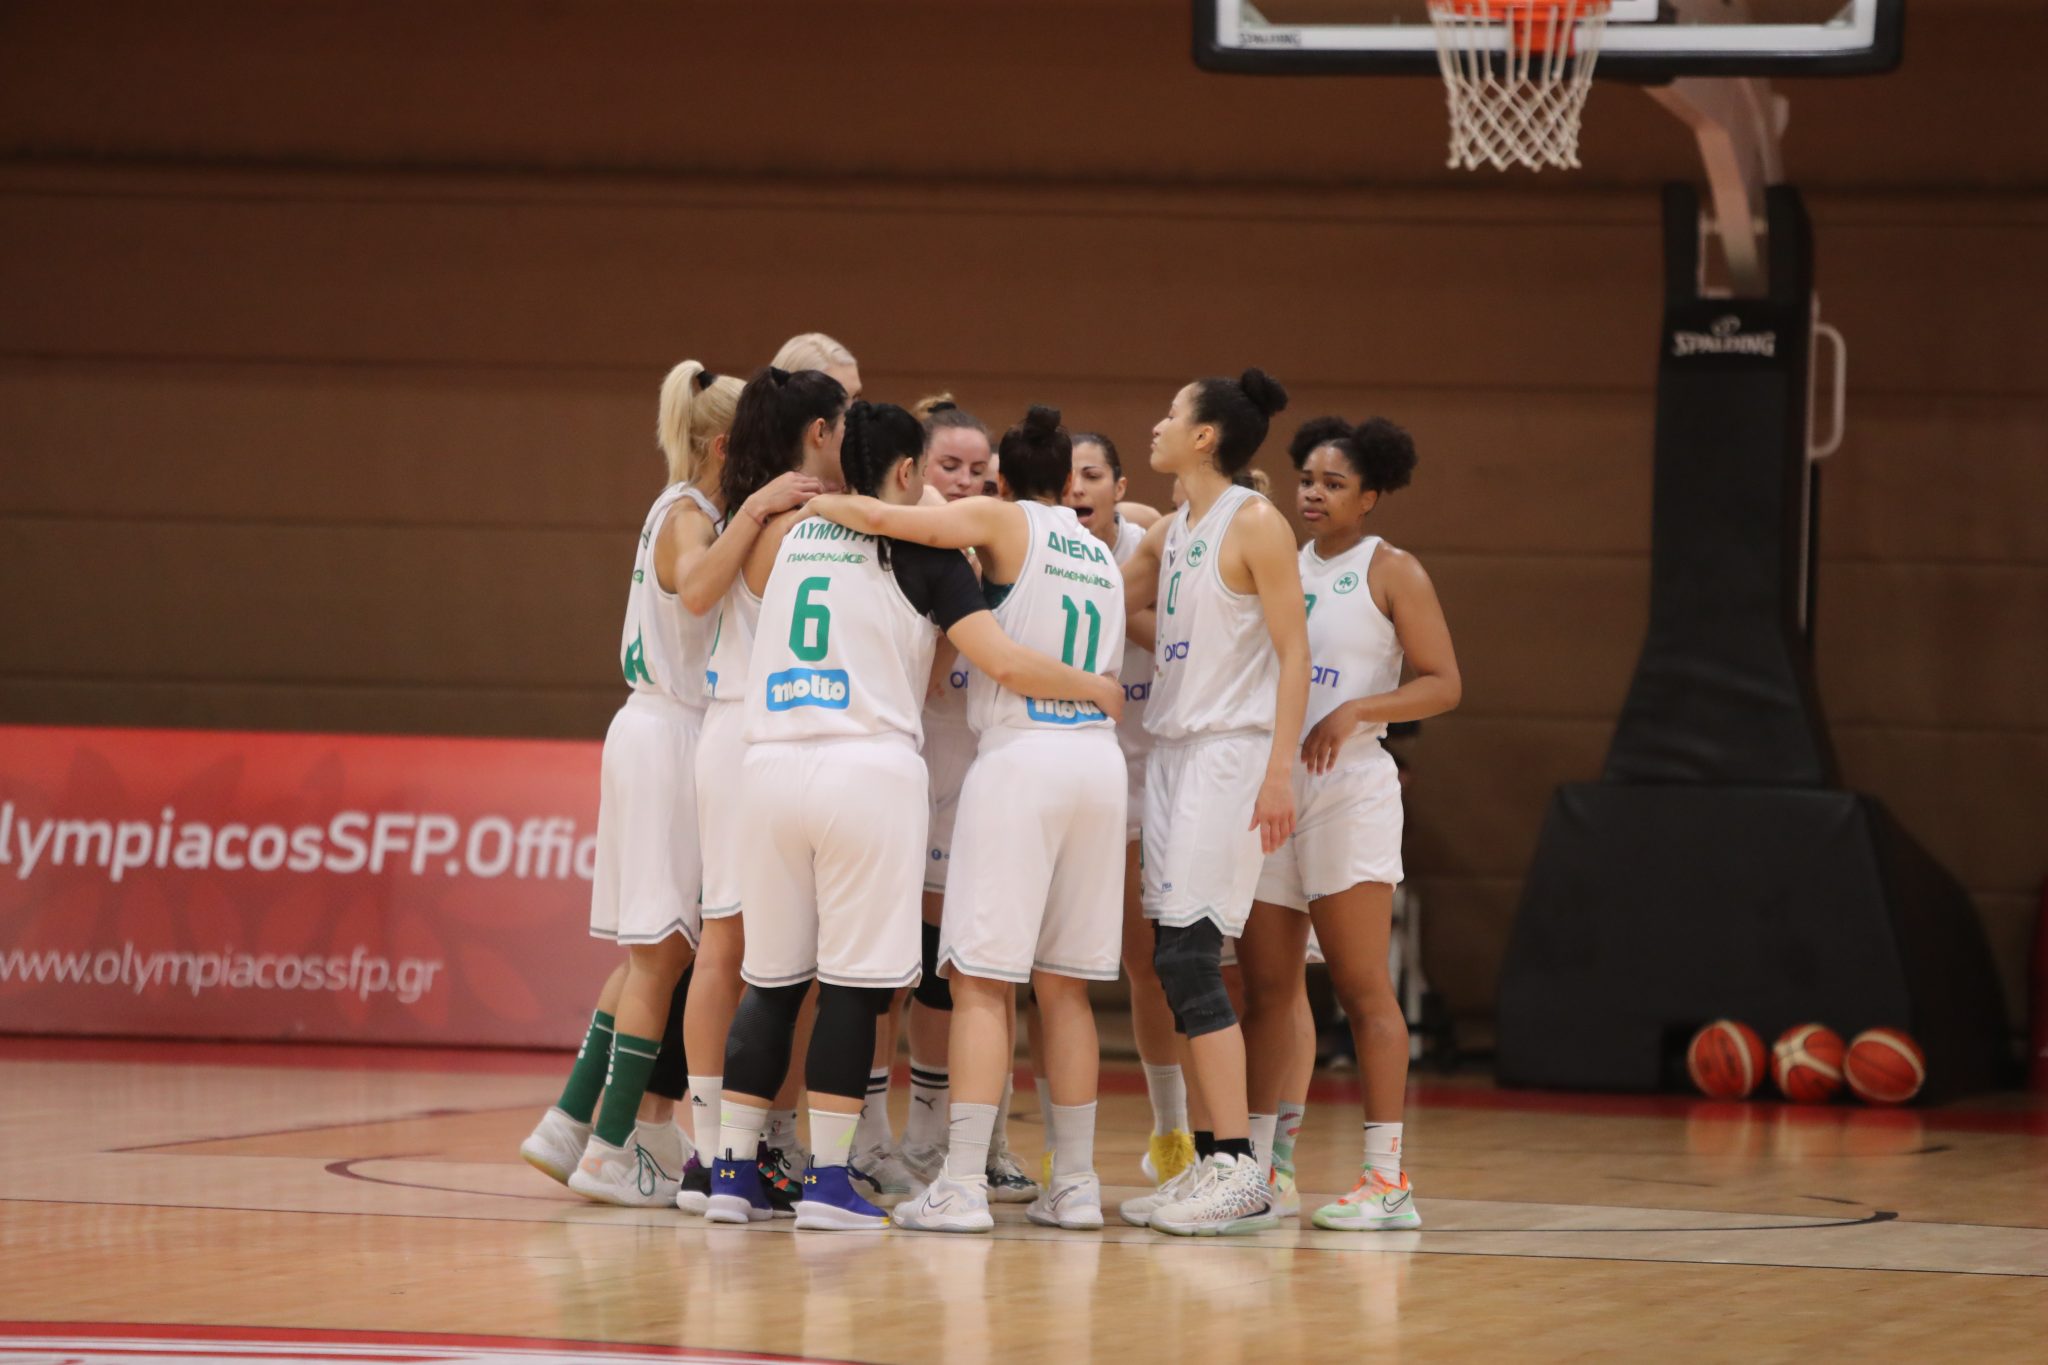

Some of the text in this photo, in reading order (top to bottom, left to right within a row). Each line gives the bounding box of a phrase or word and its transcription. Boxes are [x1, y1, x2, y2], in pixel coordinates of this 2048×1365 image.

[1672, 331, 1777, 357] SPALDING
[788, 576, 831, 662] 6
[1062, 594, 1101, 673] 11
[771, 674, 846, 703] molto
